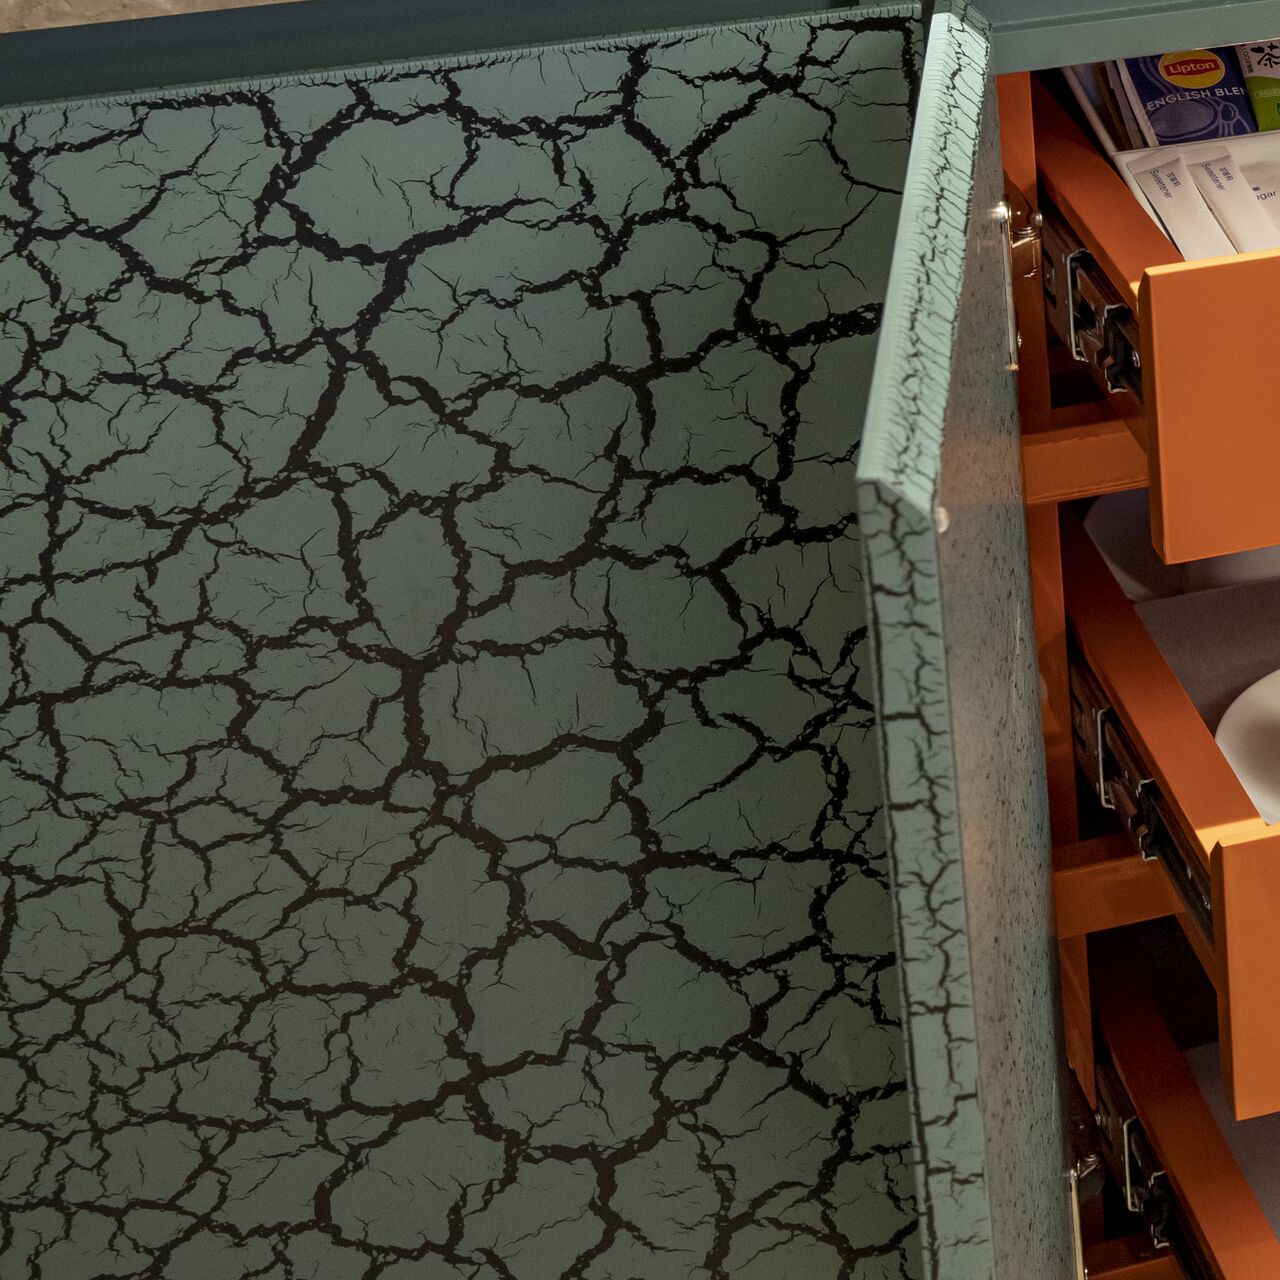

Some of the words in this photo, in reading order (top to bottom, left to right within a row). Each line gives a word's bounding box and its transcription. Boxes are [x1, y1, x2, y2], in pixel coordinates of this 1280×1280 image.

[1169, 61, 1215, 74] Lipton
[1146, 90, 1211, 111] ENGLISH
[1215, 86, 1248, 97] BLEN
[1150, 169, 1174, 199] Sweetener
[1201, 162, 1226, 191] Sweetener
[1257, 191, 1277, 201] gar
